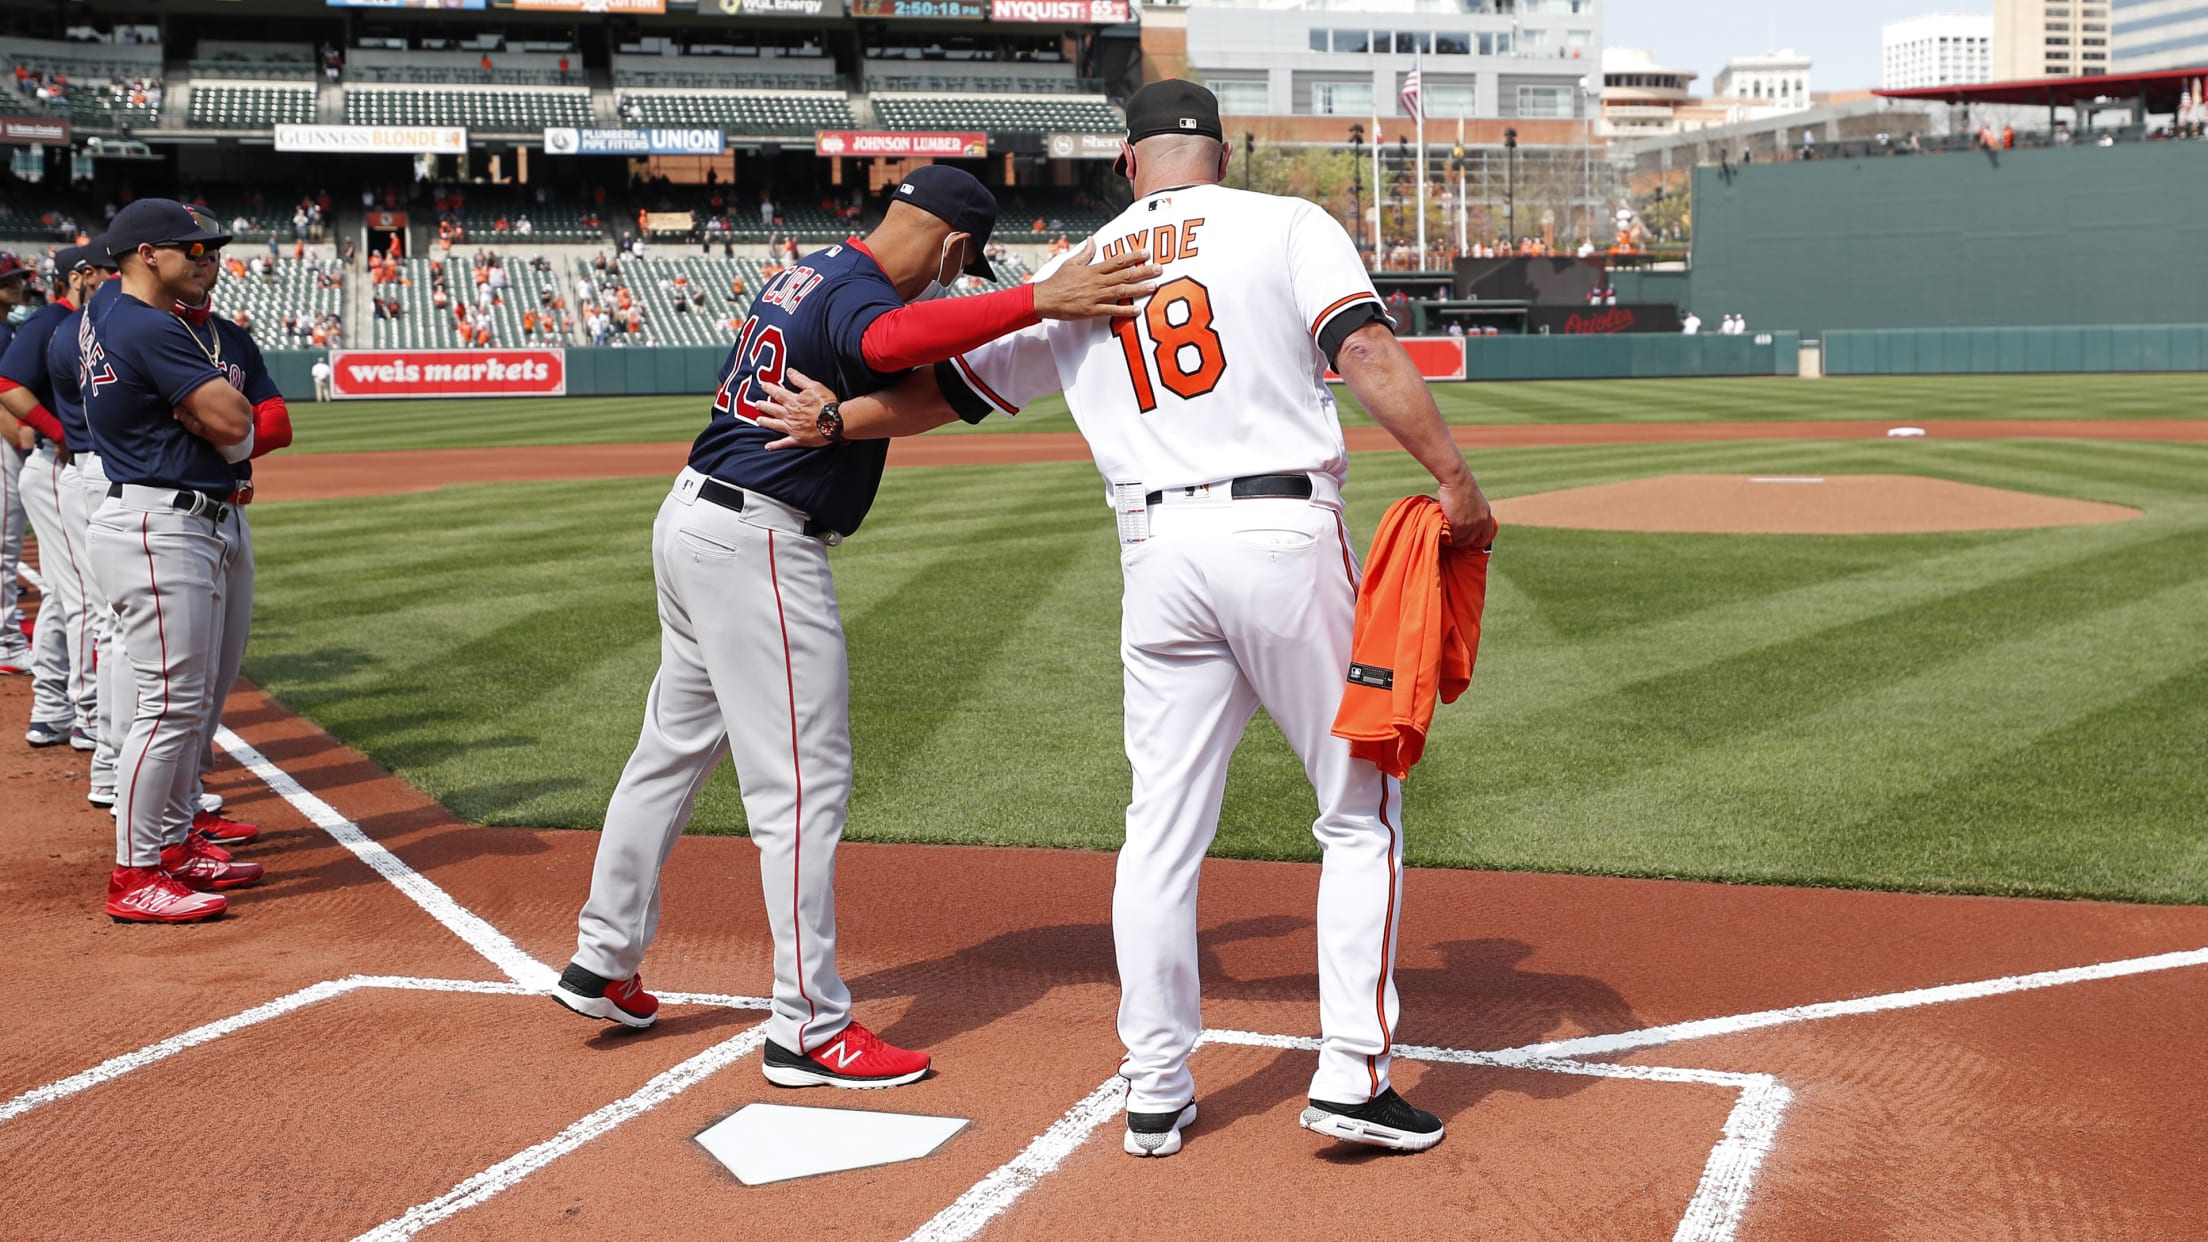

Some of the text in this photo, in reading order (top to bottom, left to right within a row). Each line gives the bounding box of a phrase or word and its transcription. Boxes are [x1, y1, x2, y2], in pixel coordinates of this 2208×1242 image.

[894, 1, 980, 16] 2:50:18 PM
[994, 1, 1081, 21] NYQUIST
[1091, 0, 1113, 14] 65
[279, 130, 438, 146] GUINNESS BLONDE
[582, 129, 638, 139] PLUMBERS
[651, 129, 719, 149] UNION
[581, 139, 649, 151] PIPE FITTERS
[852, 136, 961, 151] JOHNSON LUMBER
[1109, 274, 1227, 414] 18
[349, 358, 548, 383] weis markets
[713, 314, 788, 428] 13
